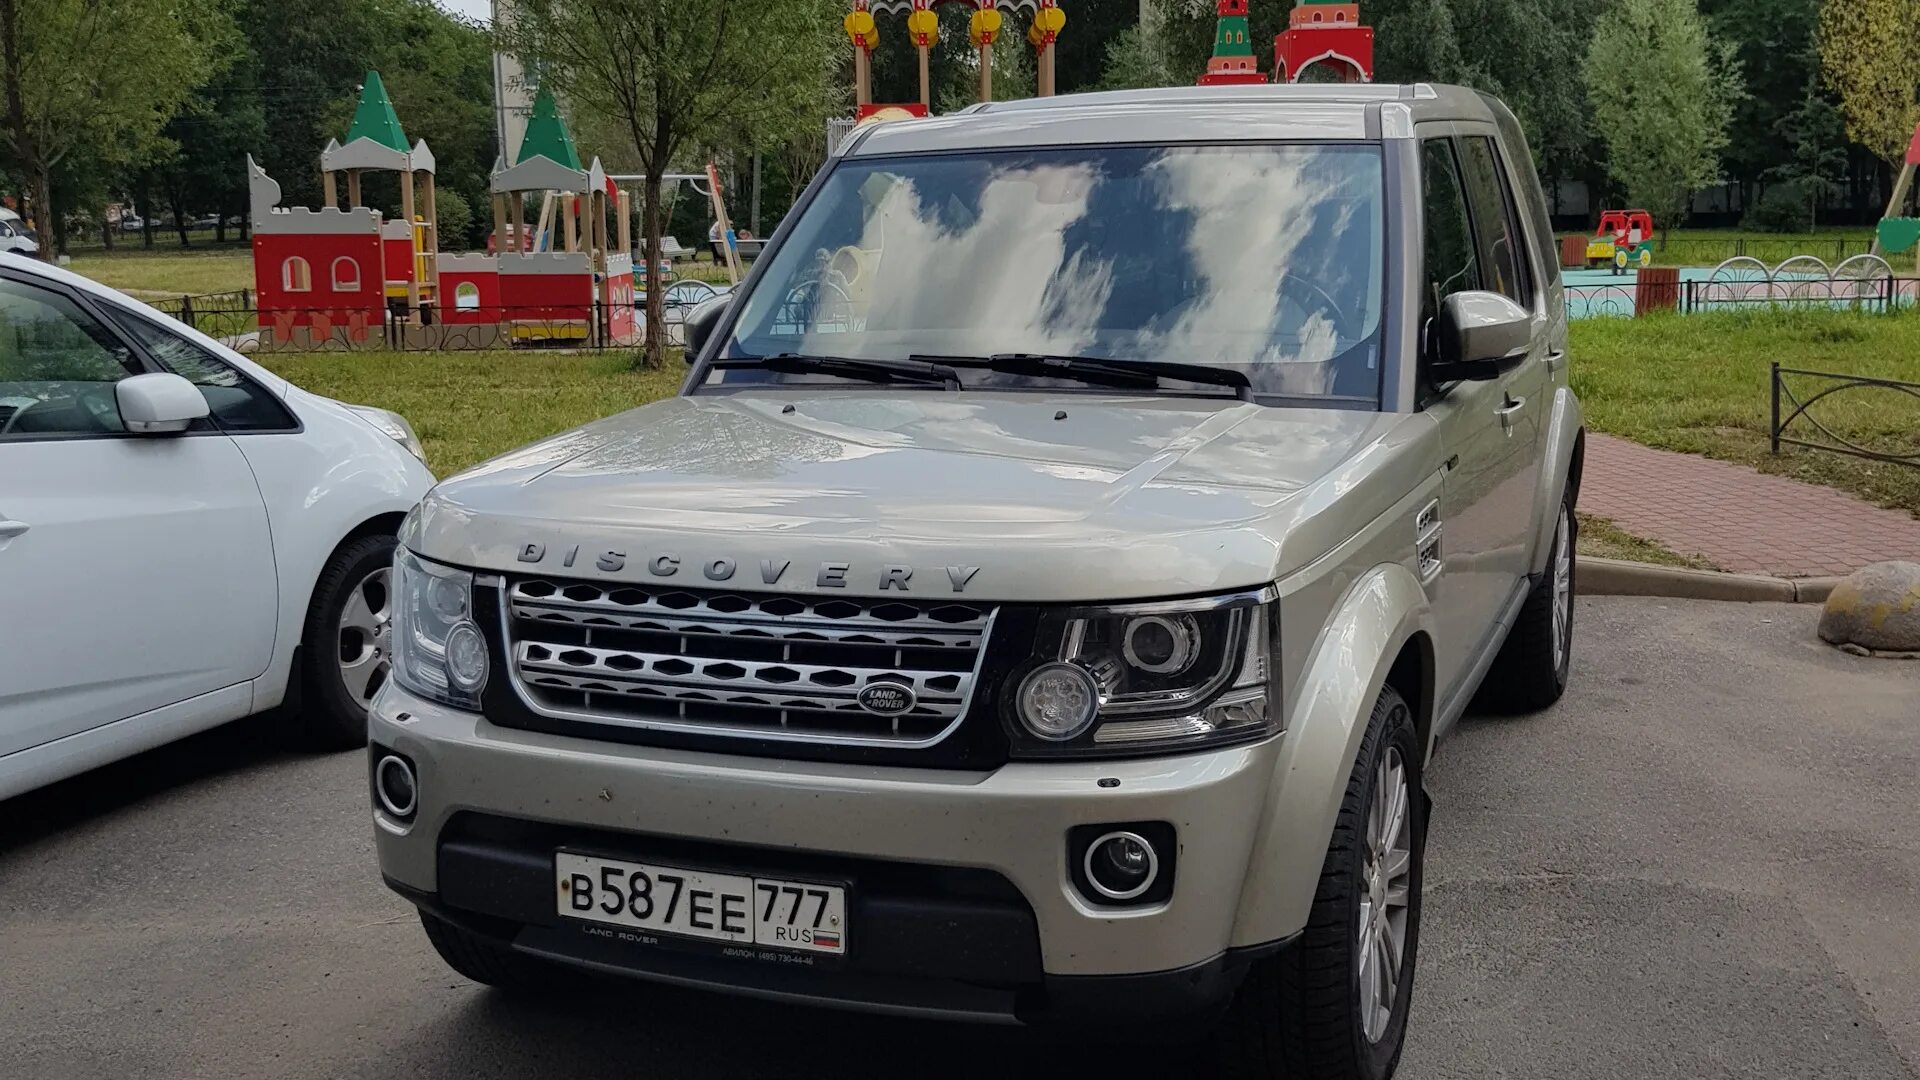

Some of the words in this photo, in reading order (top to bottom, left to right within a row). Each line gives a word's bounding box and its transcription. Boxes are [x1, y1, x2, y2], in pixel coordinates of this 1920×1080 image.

[517, 542, 980, 593] DISCOVERY
[869, 690, 897, 699] LAND
[871, 699, 905, 709] ROVER
[757, 883, 829, 928] 777
[582, 924, 614, 938] LAND
[618, 931, 658, 945] ROVER
[775, 926, 812, 943] RUS
